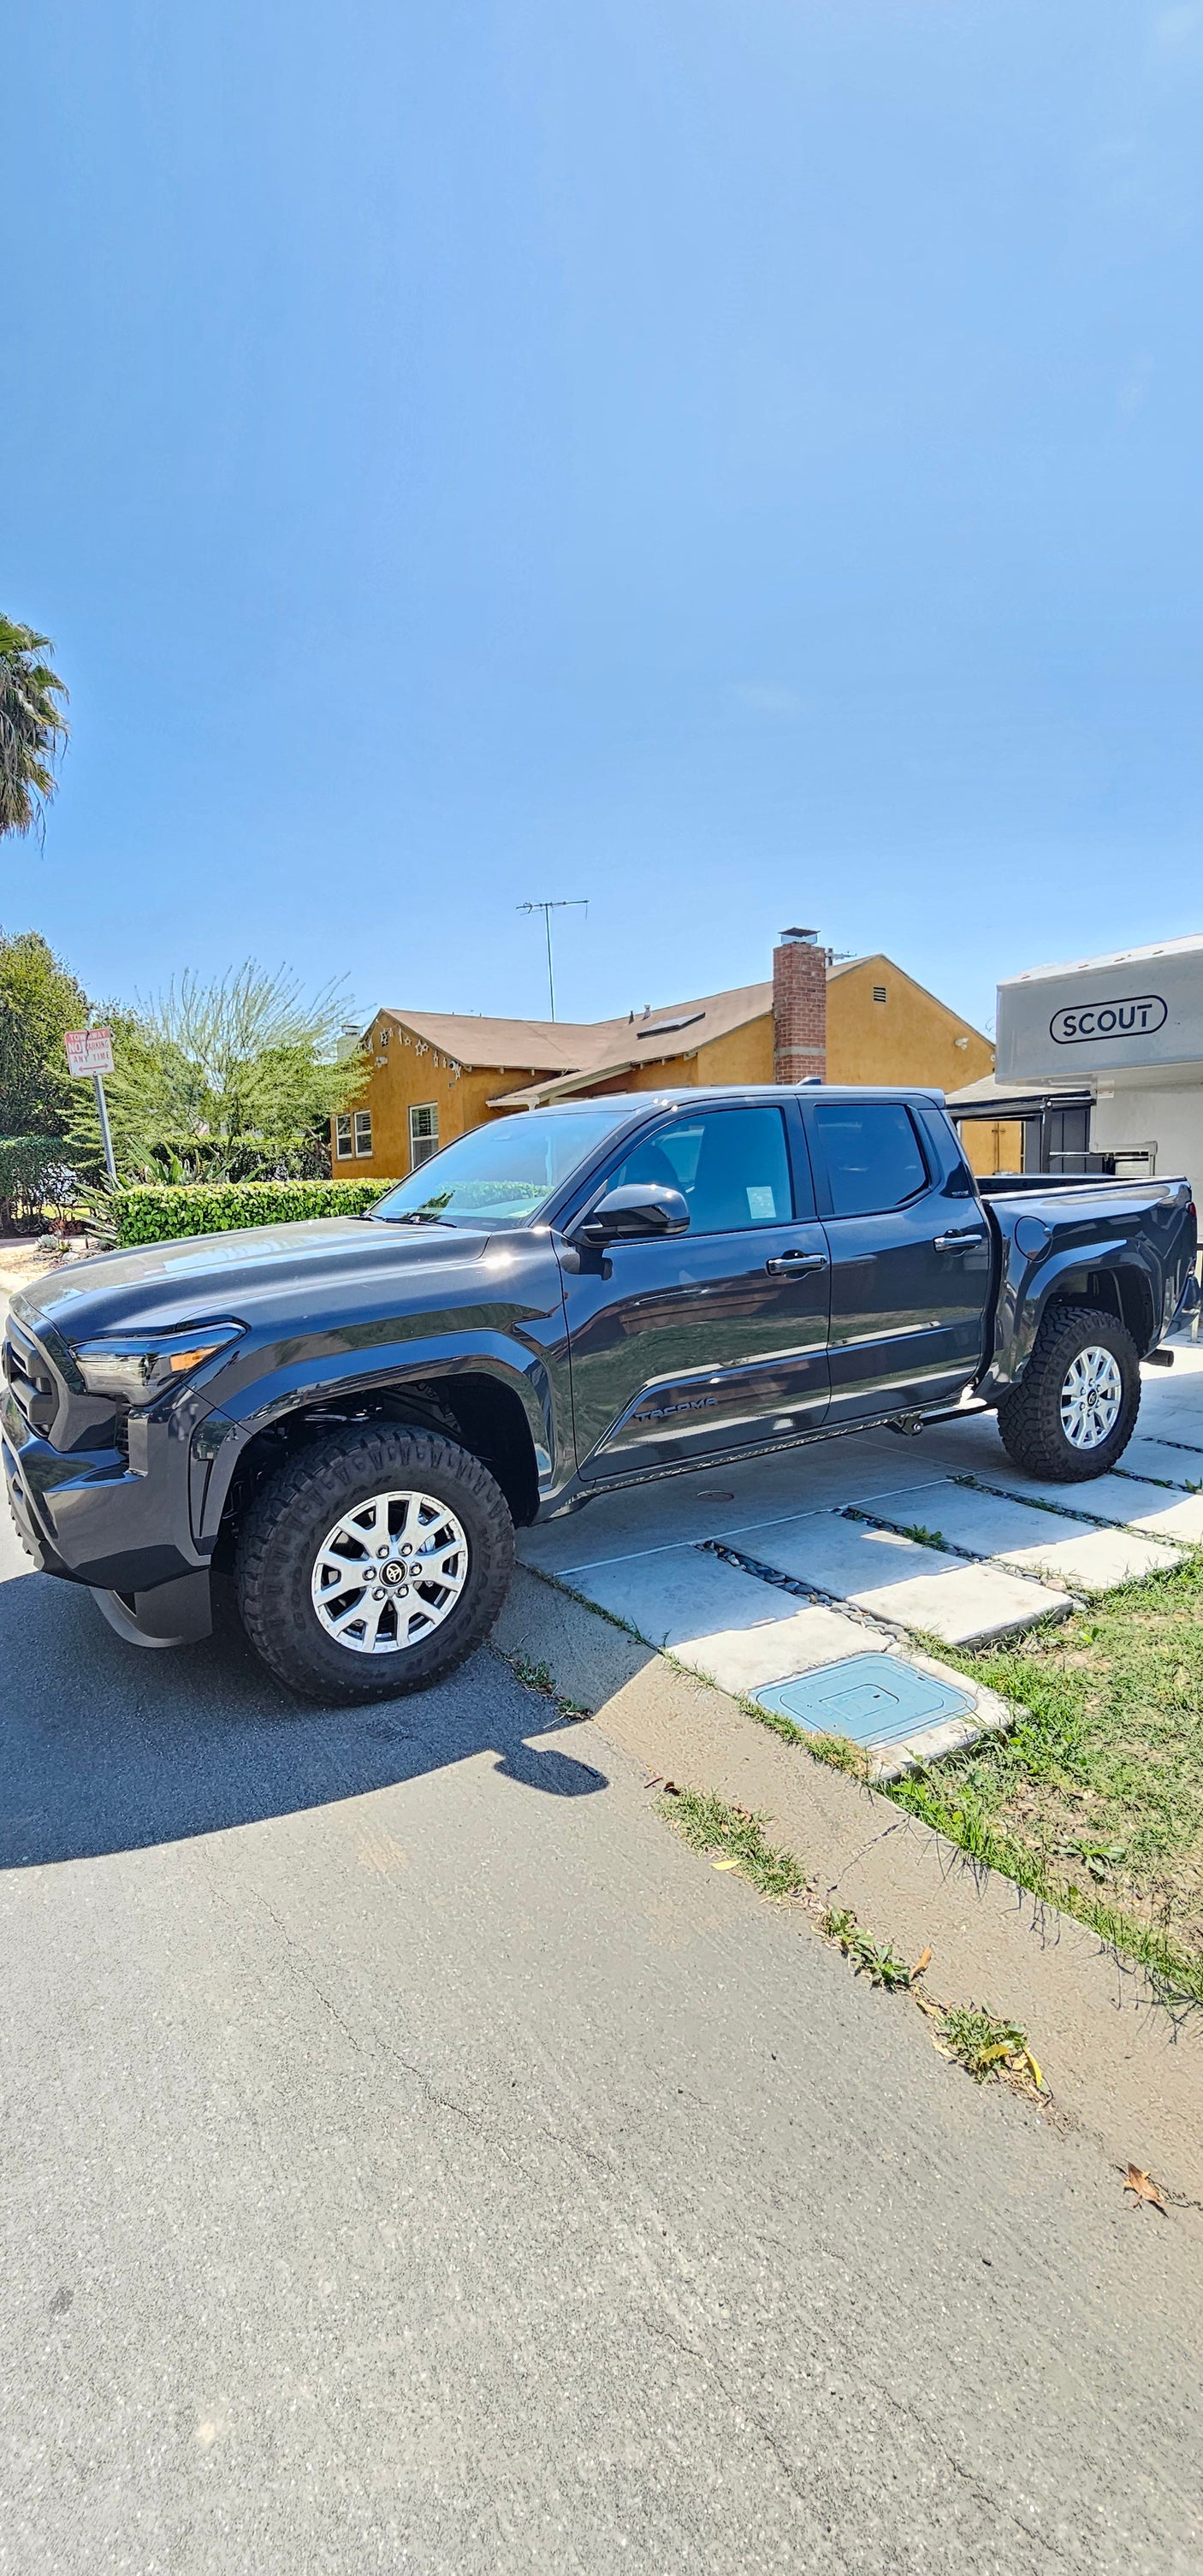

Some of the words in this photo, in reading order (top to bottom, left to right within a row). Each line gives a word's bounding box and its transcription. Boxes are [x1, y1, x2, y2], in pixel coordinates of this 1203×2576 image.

[1063, 1004, 1153, 1037] SCOUT
[68, 1041, 81, 1053] NO
[86, 1040, 110, 1050] ARKING
[92, 1051, 110, 1061] TIME
[633, 1396, 718, 1422] TACOMA
